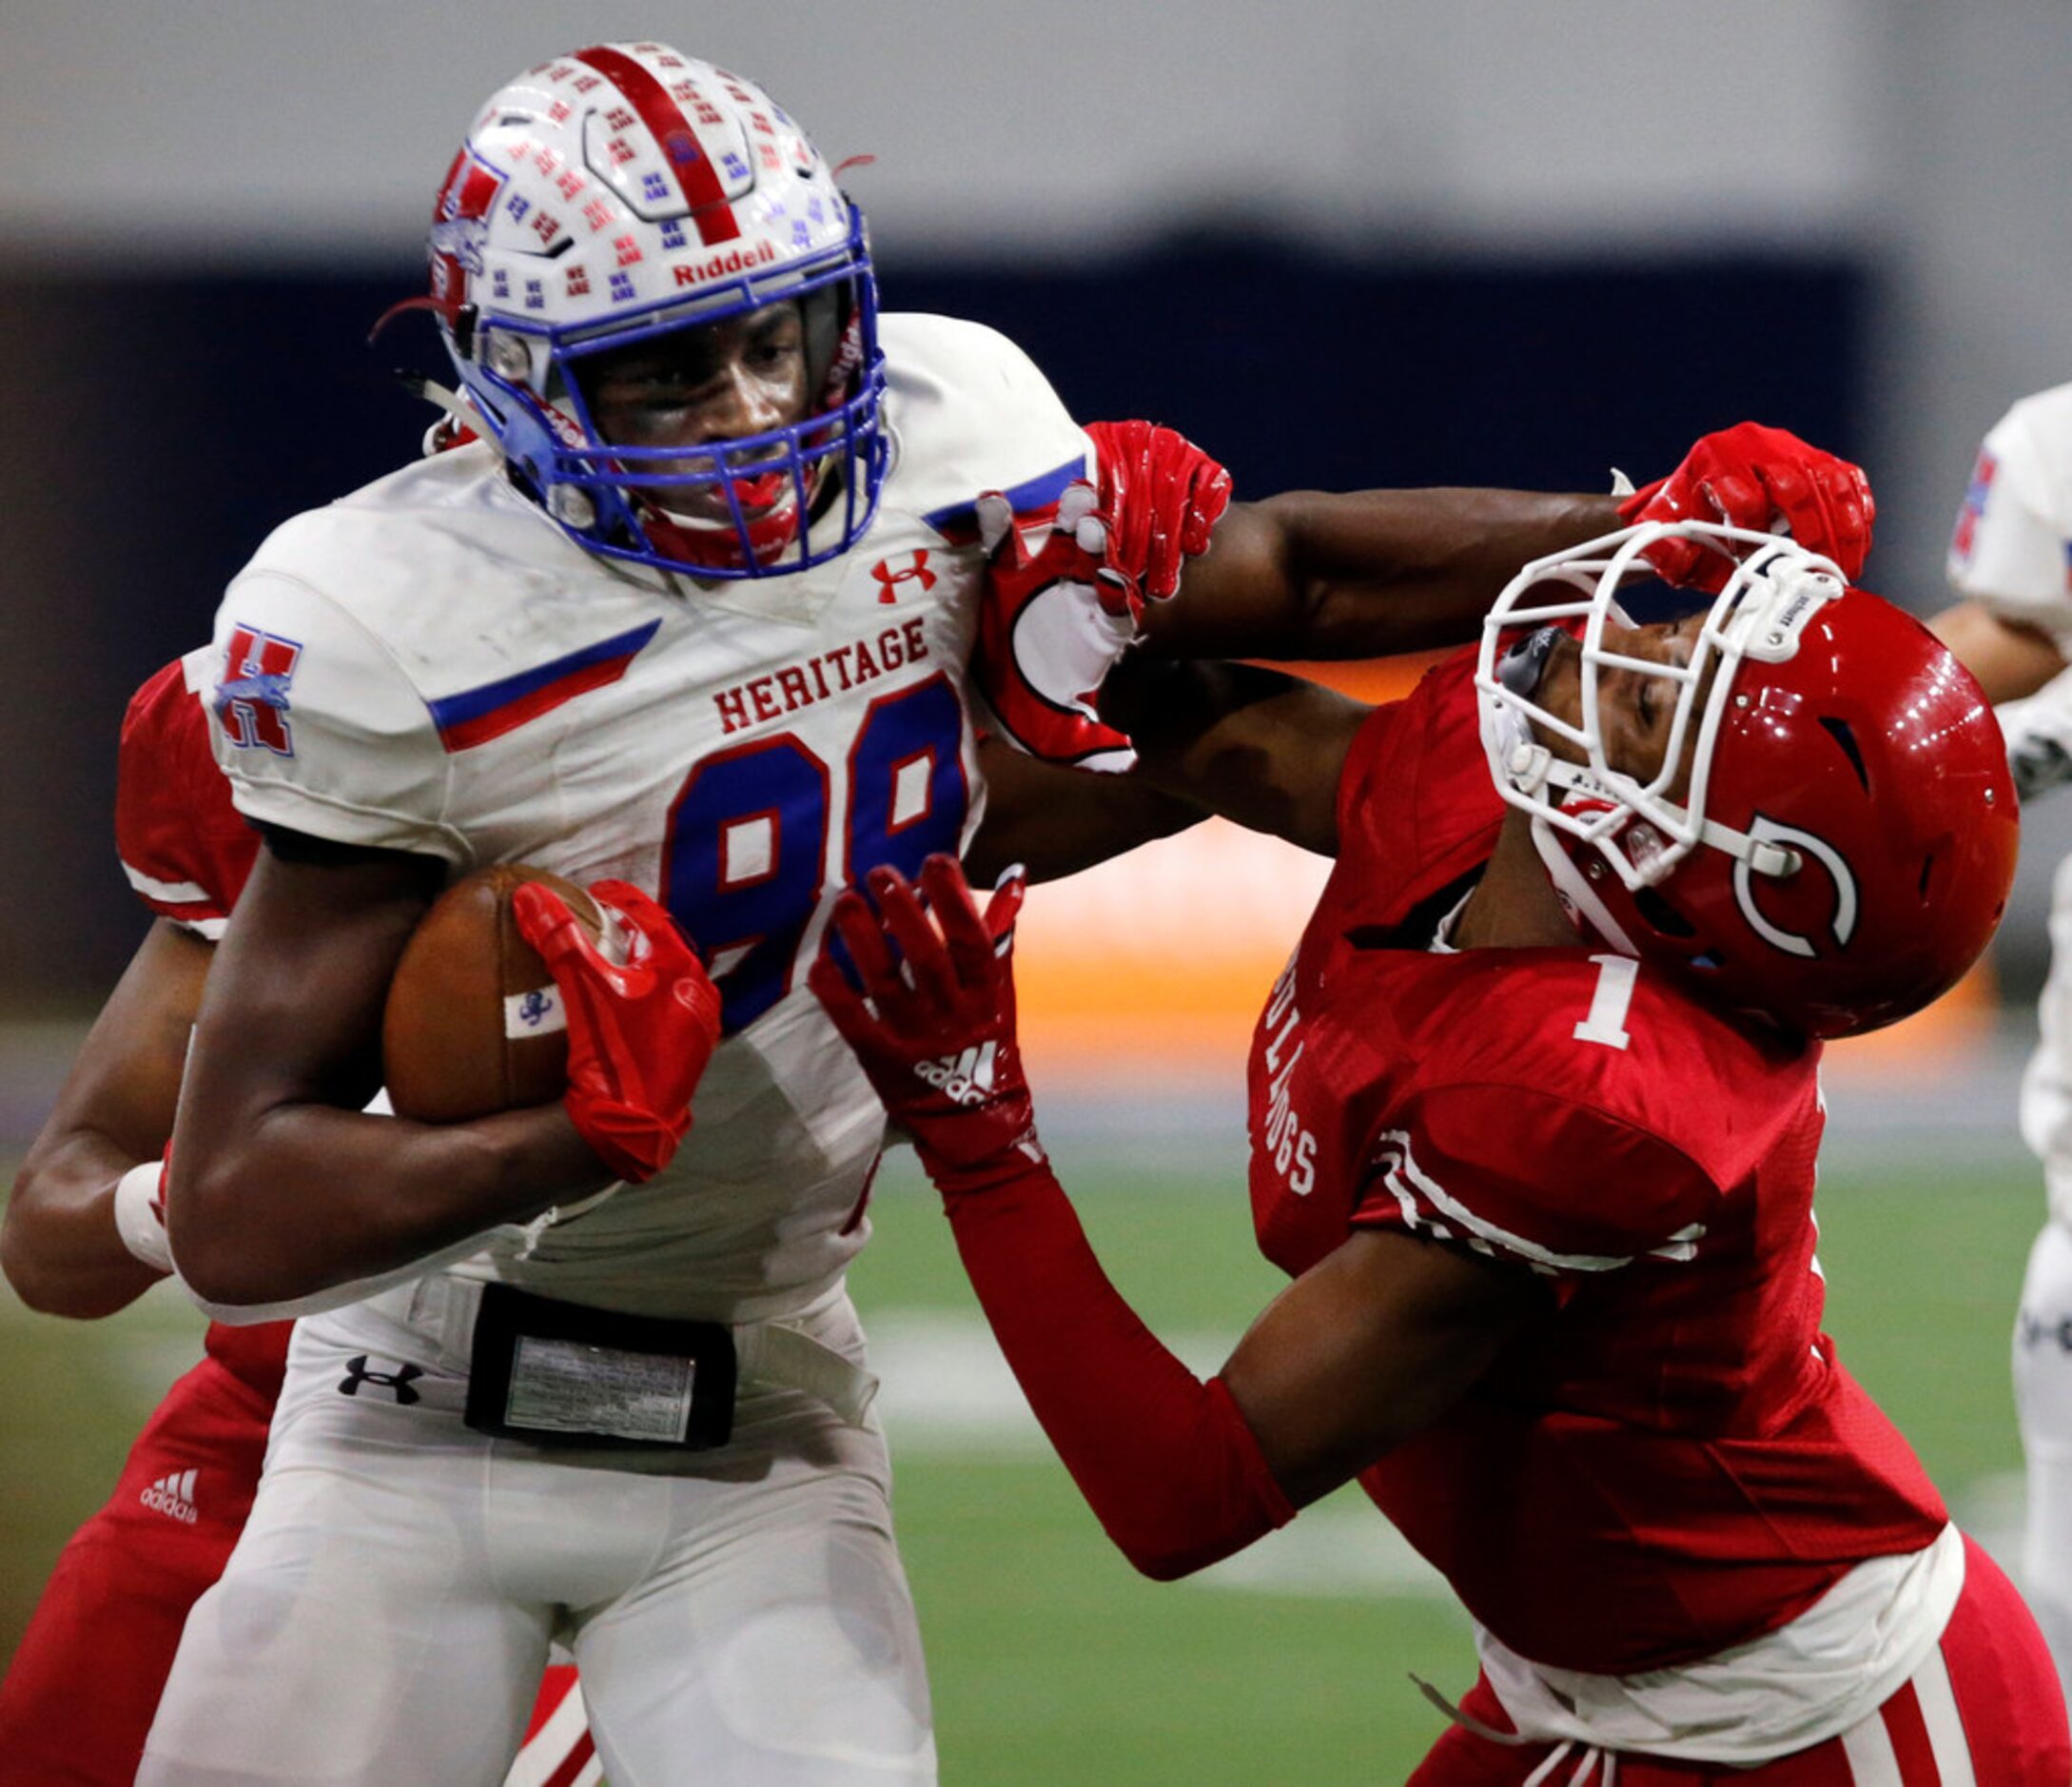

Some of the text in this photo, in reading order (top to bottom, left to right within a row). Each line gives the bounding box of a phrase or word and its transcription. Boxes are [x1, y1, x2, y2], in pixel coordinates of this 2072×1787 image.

[672, 239, 775, 287] Riddell
[712, 617, 929, 735] HERITAGE
[1572, 954, 1640, 1051] 1
[913, 1058, 987, 1107] adida
[1265, 944, 1317, 1197] ULLOGS
[139, 1486, 198, 1524] adidas
